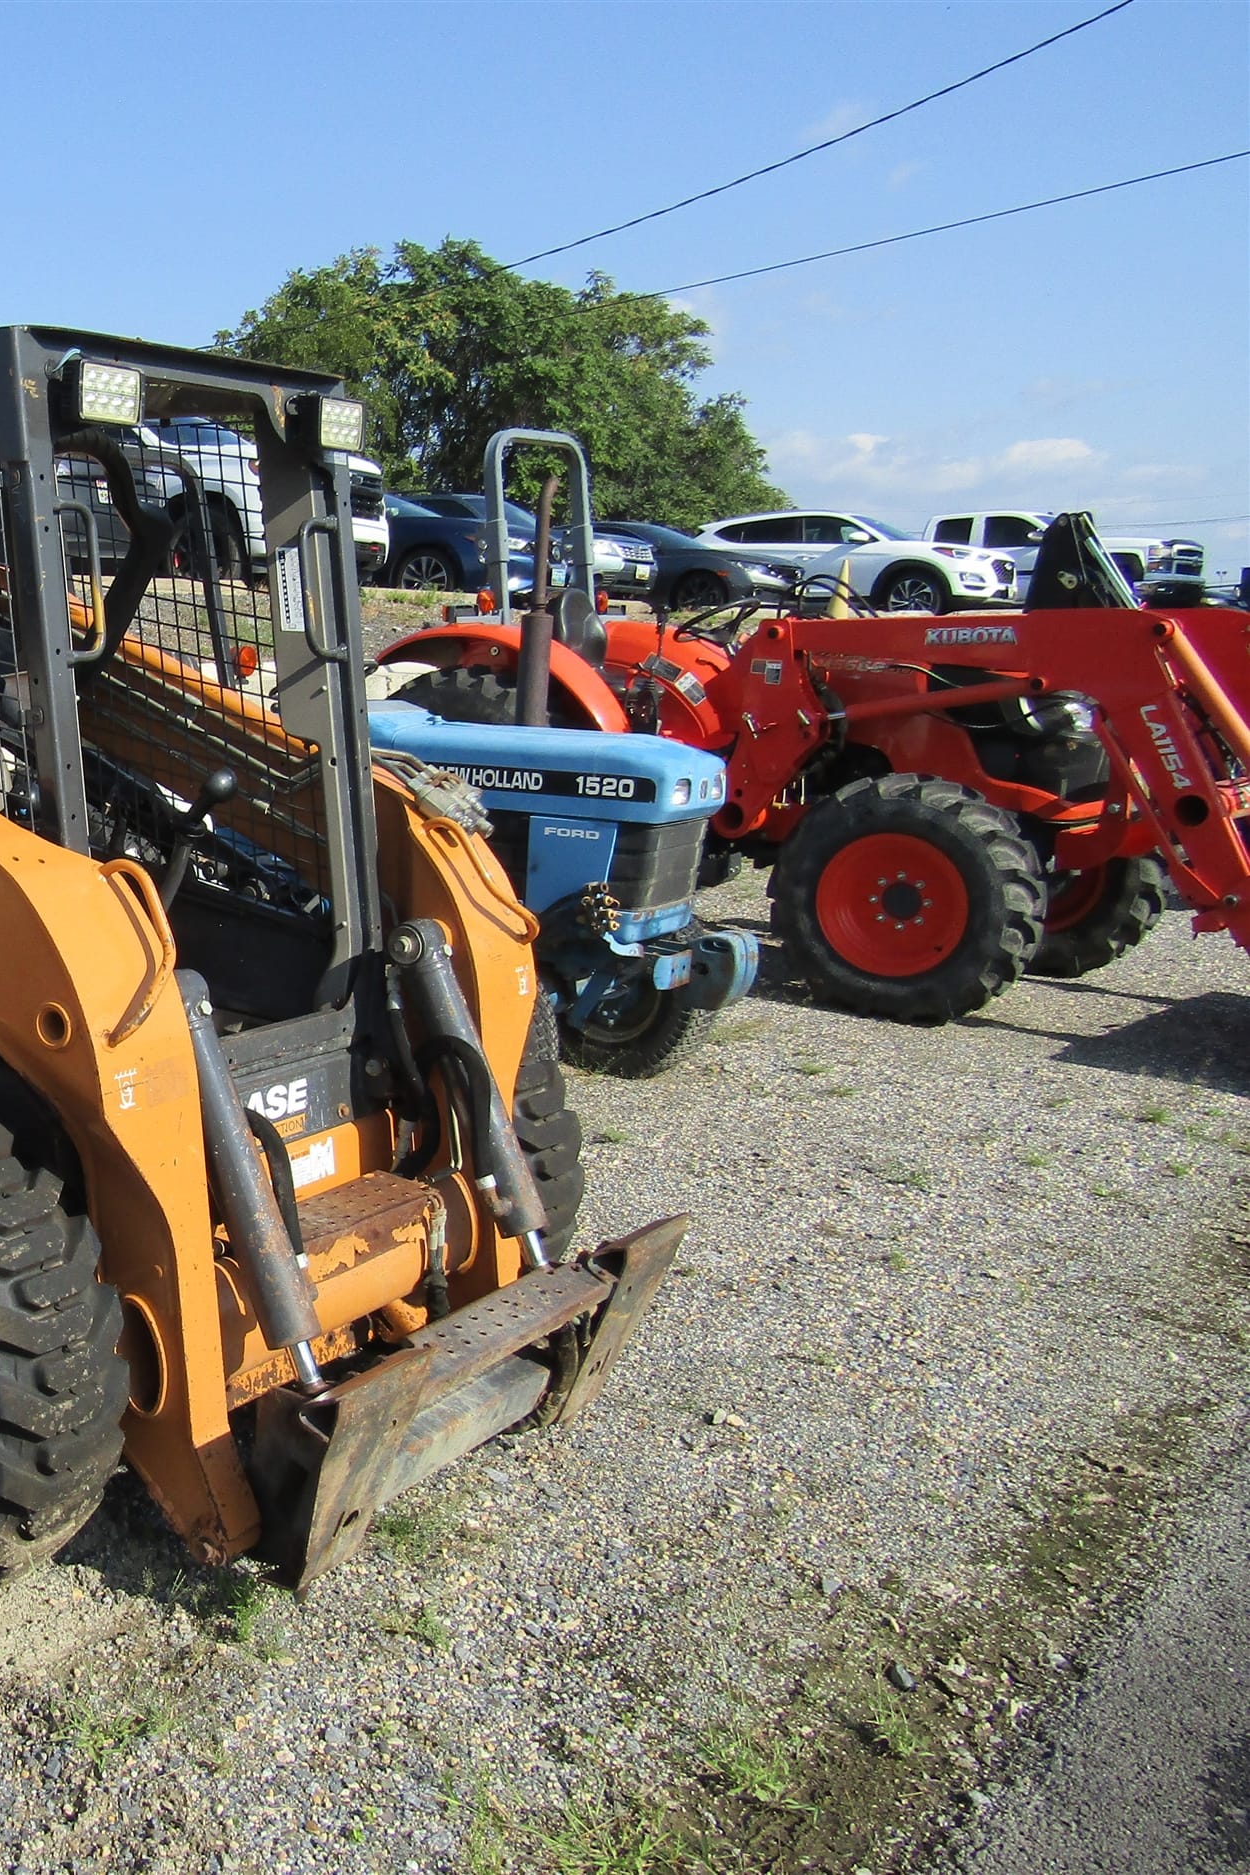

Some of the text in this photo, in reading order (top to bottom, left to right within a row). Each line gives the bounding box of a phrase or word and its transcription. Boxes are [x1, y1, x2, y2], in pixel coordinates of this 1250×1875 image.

[926, 627, 1017, 645] KUBOTA
[1140, 705, 1192, 789] LA1154
[472, 768, 543, 791] HOLLAND
[575, 776, 635, 798] 1520
[544, 827, 600, 840] FORD
[246, 1077, 308, 1120] ASE
